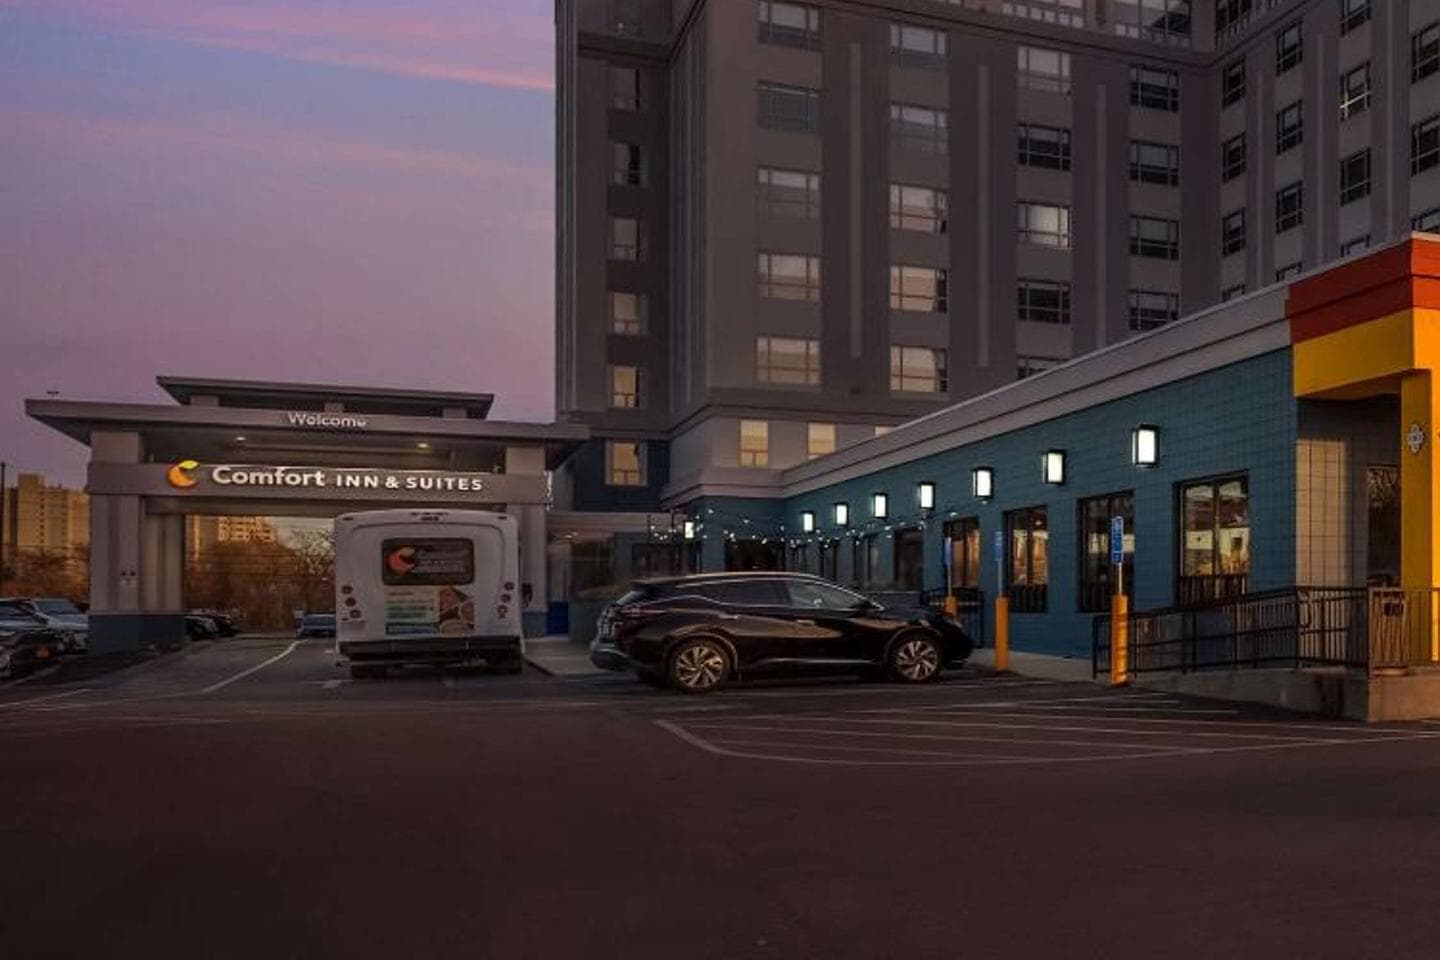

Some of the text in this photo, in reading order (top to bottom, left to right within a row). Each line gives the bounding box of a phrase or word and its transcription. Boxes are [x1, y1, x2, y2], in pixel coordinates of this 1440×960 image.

[287, 411, 368, 428] Welcome
[212, 466, 483, 491] Comfort INN & SUITES
